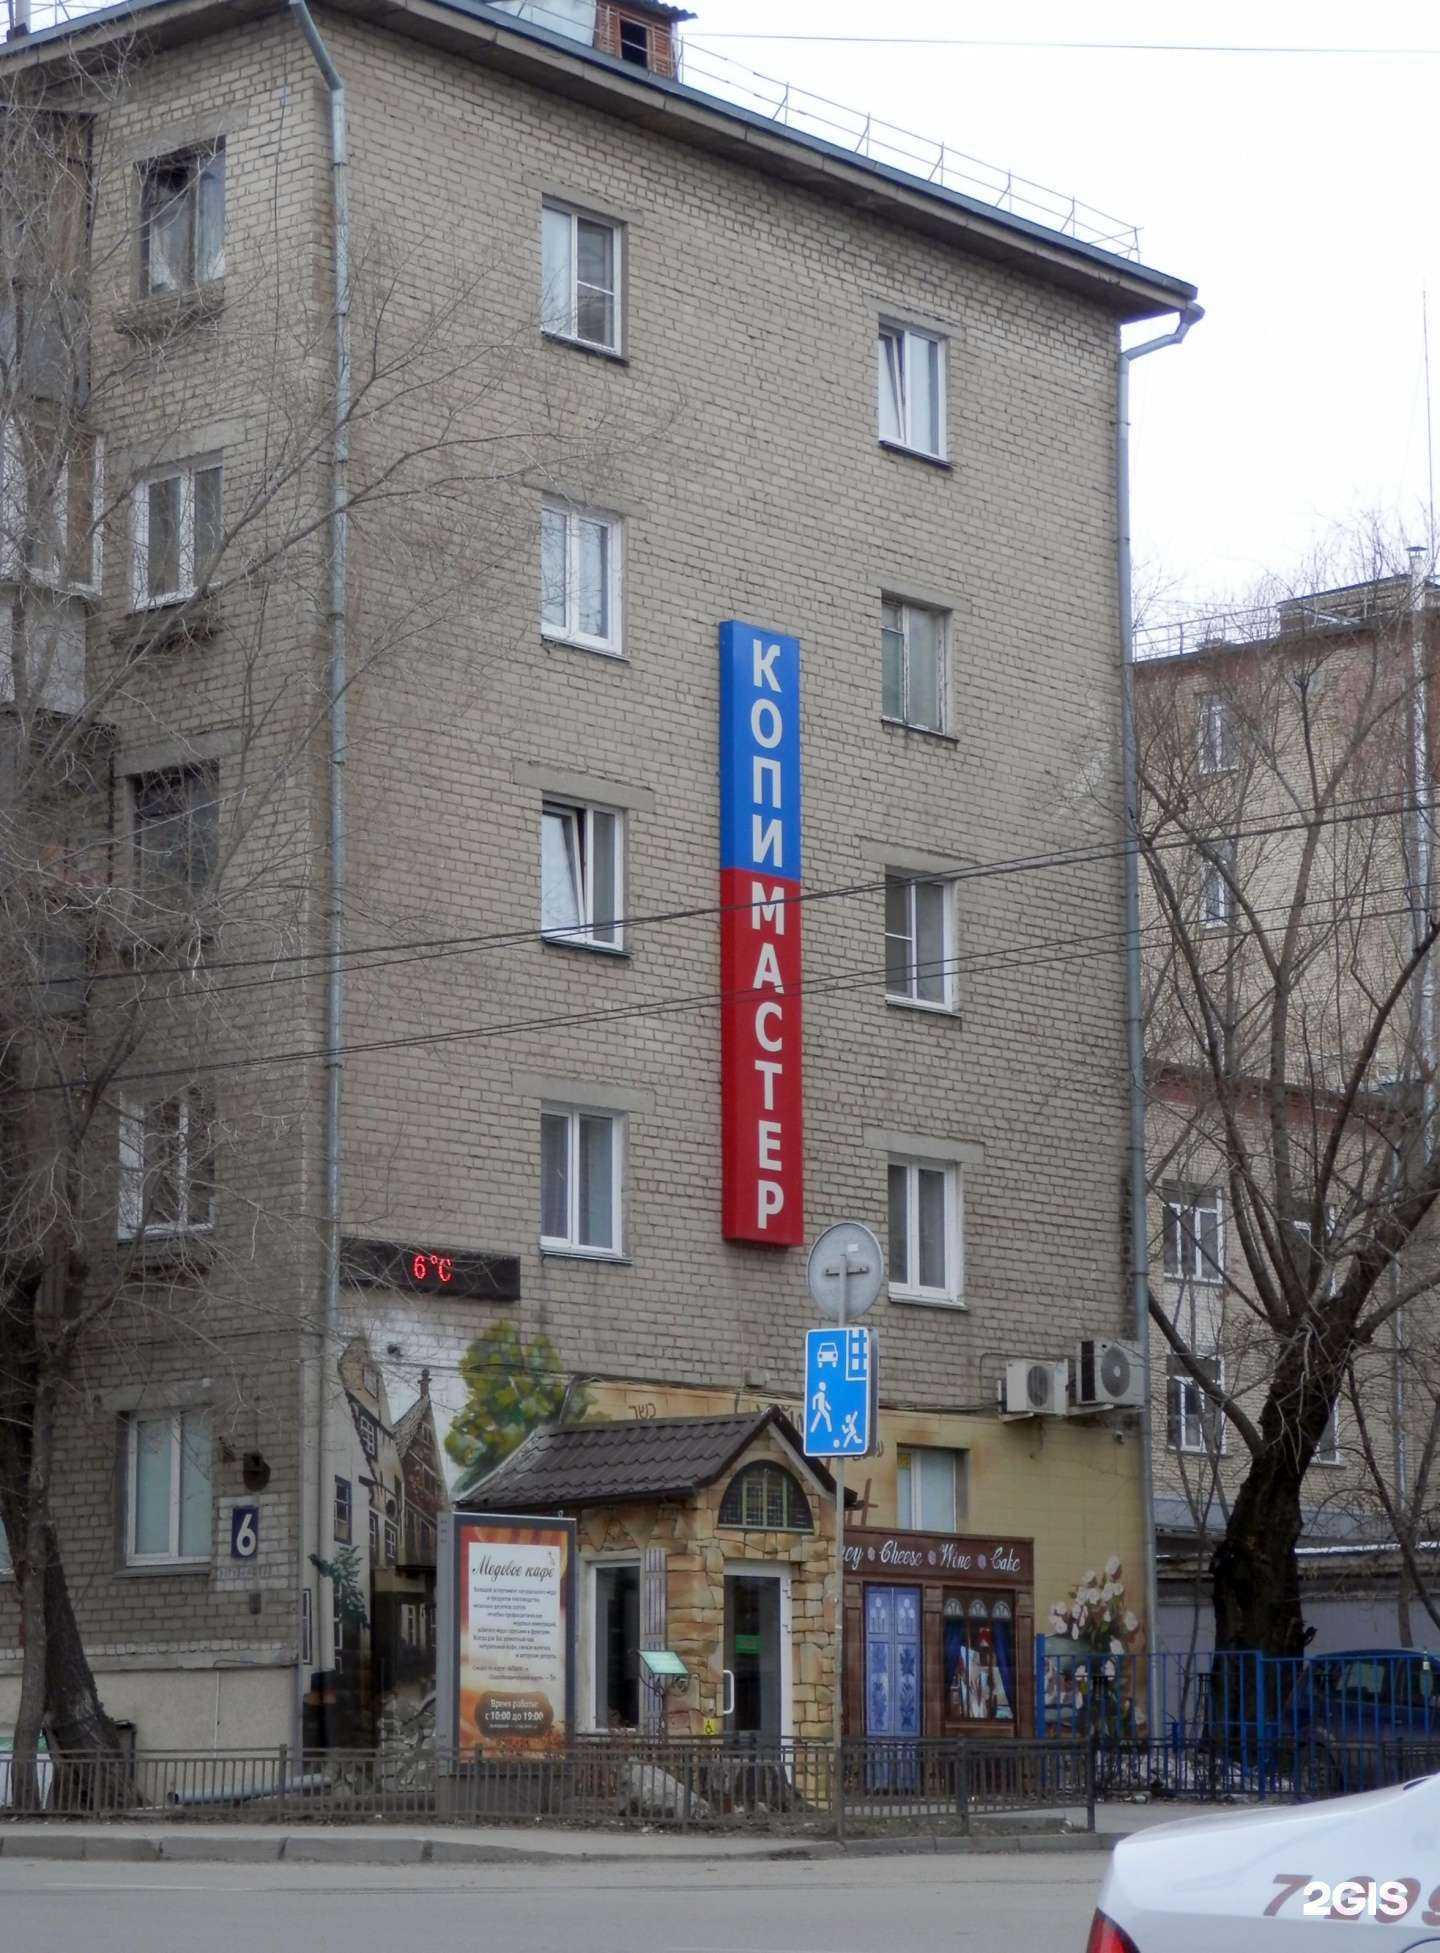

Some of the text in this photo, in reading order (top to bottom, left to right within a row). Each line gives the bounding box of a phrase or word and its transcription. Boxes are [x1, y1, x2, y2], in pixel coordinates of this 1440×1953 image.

[750, 638, 786, 1230] КОПИ МАСТЕР
[236, 1513, 257, 1556] 6
[880, 1539, 924, 1567] Cheese
[939, 1543, 972, 1570] Wine
[990, 1546, 1021, 1572] Cake
